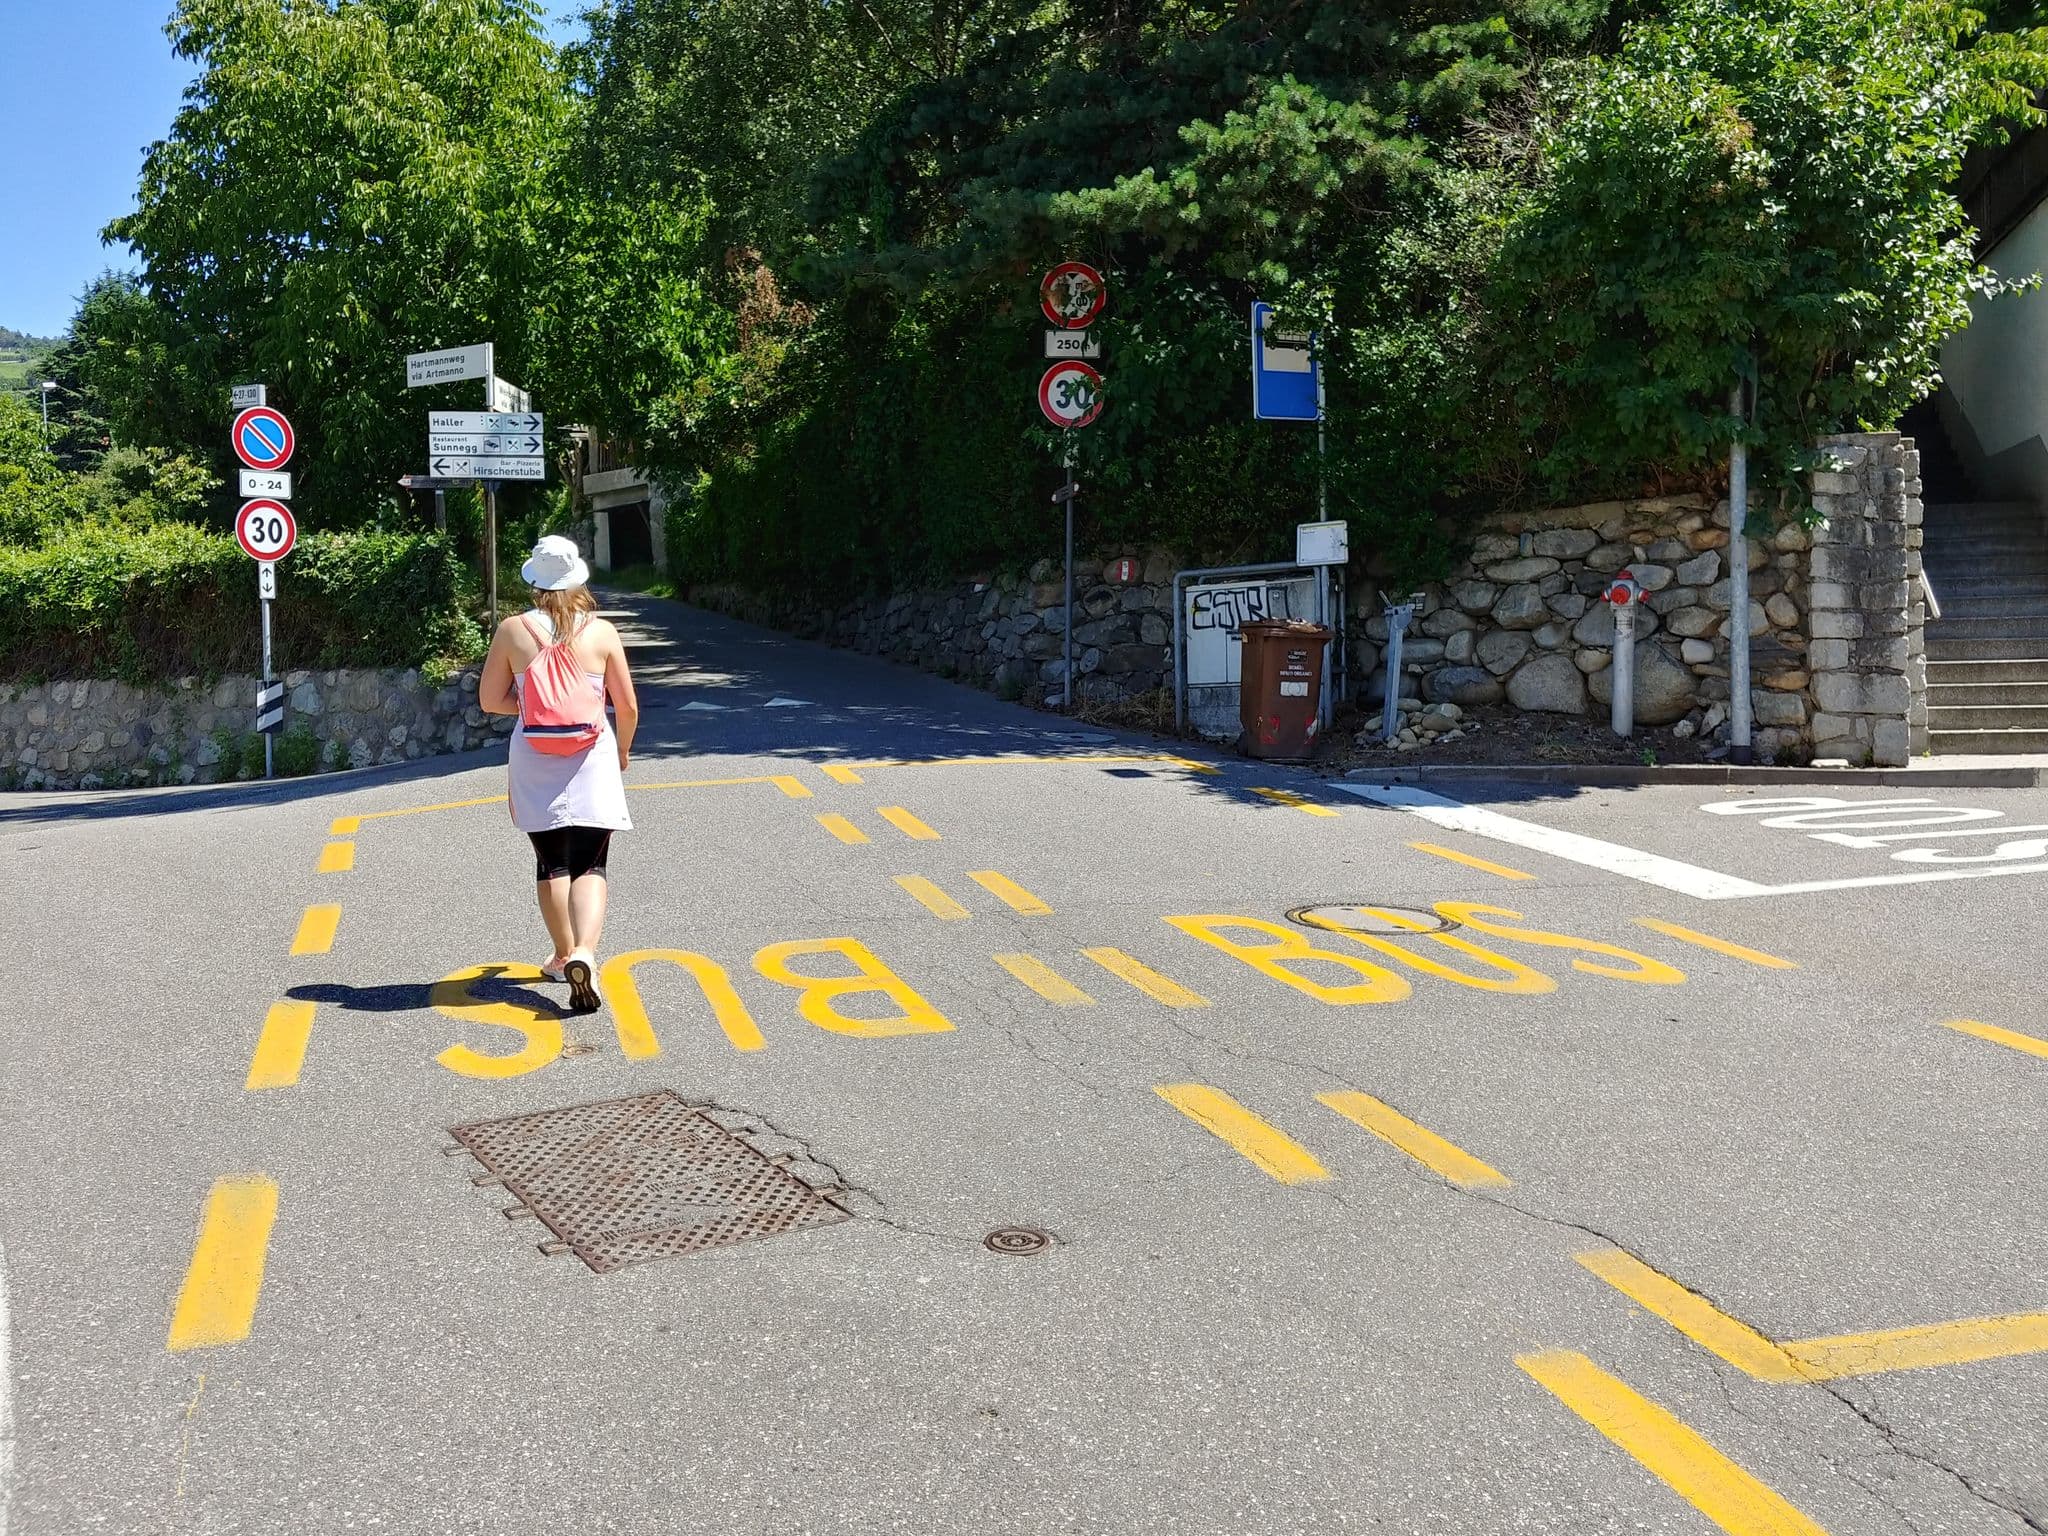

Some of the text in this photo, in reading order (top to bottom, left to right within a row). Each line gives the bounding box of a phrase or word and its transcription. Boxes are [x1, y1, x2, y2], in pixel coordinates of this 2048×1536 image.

[1056, 339, 1080, 350] 250
[410, 354, 465, 370] Hartmannweg
[411, 366, 464, 381] via Artmanno
[1056, 379, 1090, 409] 30
[432, 418, 465, 427] Haller
[433, 443, 478, 454] Sunnegg
[474, 466, 541, 476] Hirscherstube
[248, 478, 256, 489] 0
[267, 480, 283, 491] 24
[251, 516, 283, 544] 30
[1162, 901, 1687, 1007] BUS
[435, 936, 957, 1080] BUS
